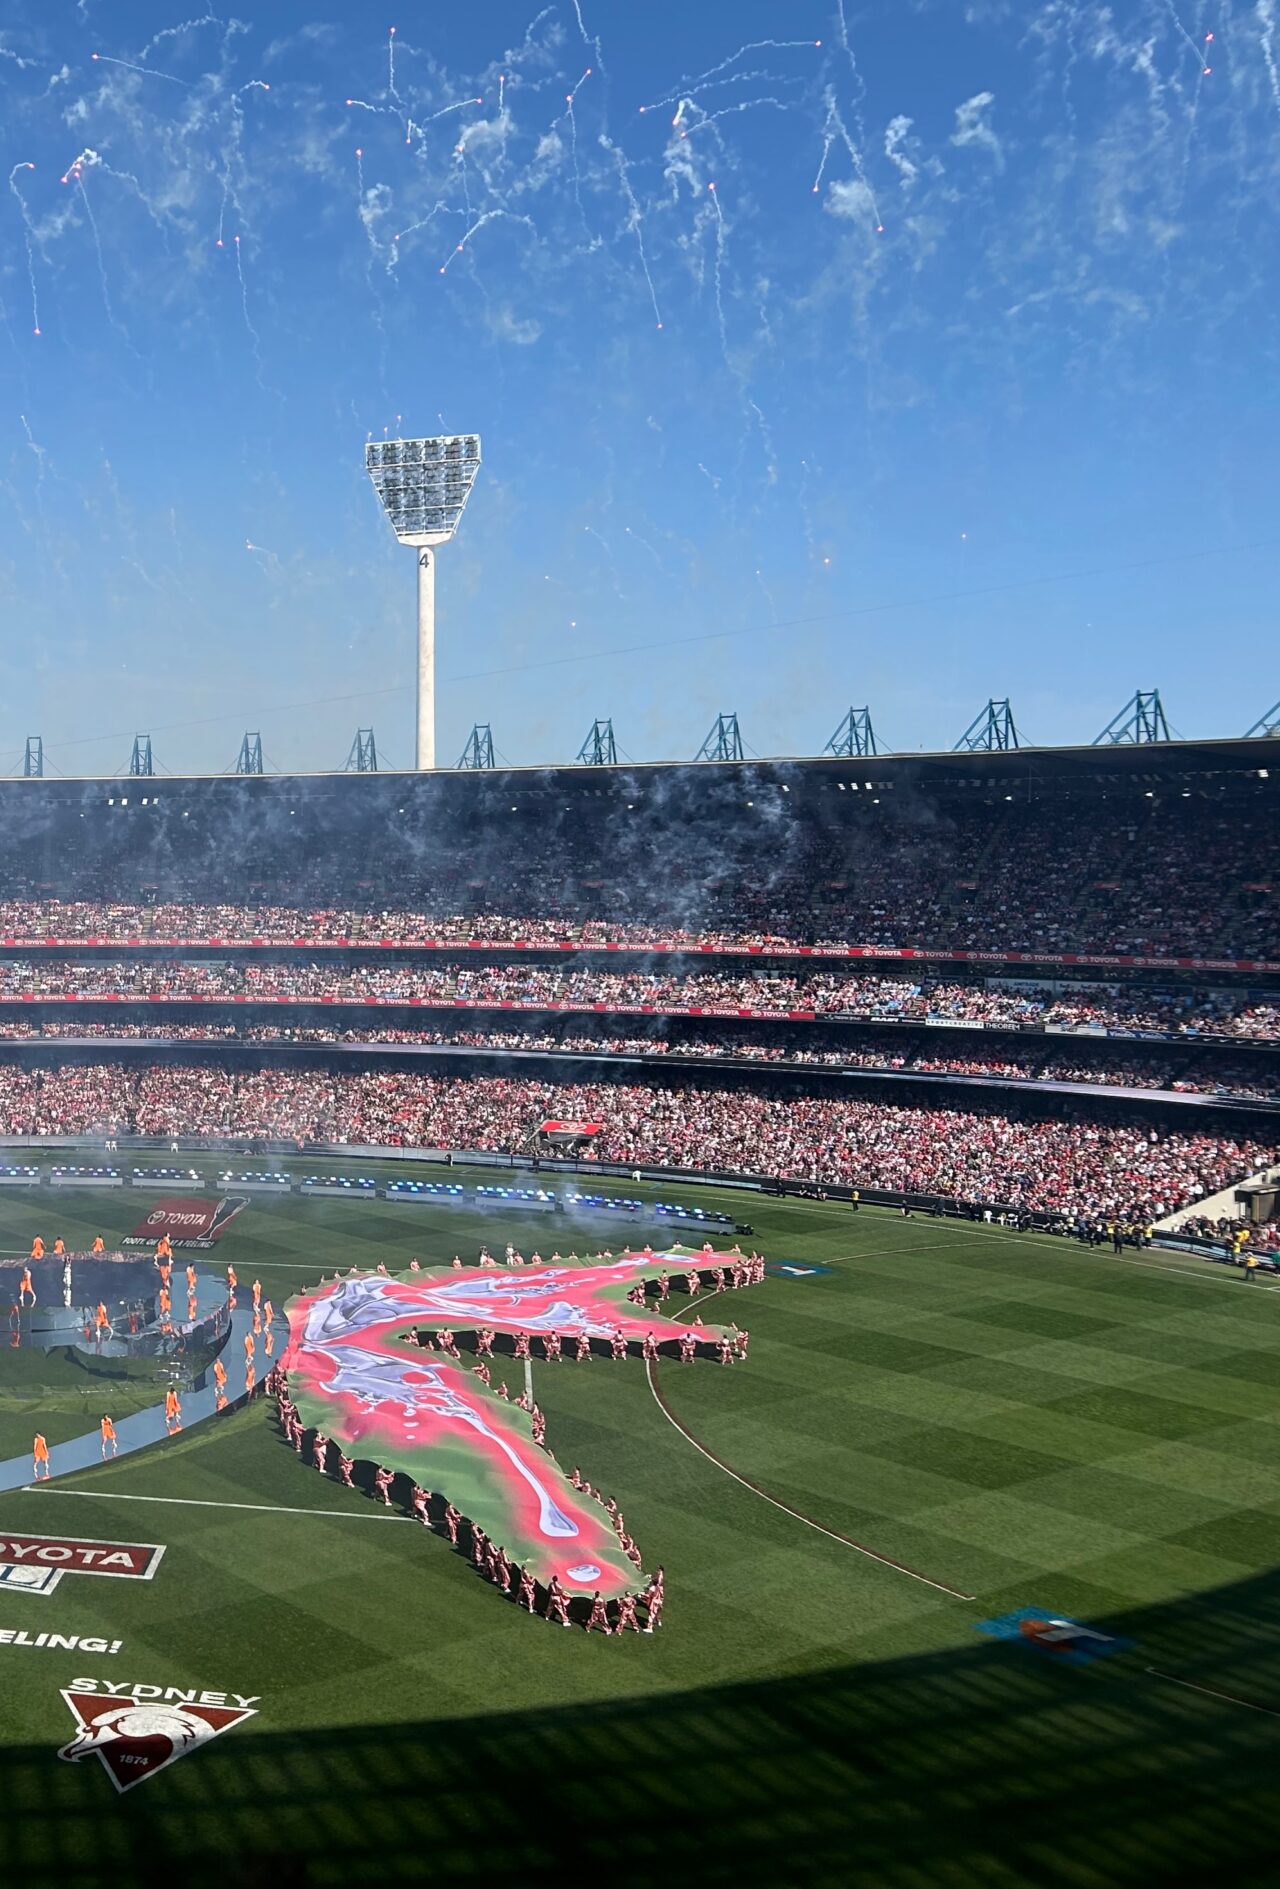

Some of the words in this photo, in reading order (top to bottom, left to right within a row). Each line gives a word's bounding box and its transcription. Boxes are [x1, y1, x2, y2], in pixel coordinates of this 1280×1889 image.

[419, 553, 430, 569] 4
[165, 1213, 207, 1225] TOYOTA
[68, 1677, 263, 1708] SYDNEY
[119, 1753, 149, 1766] 1874
